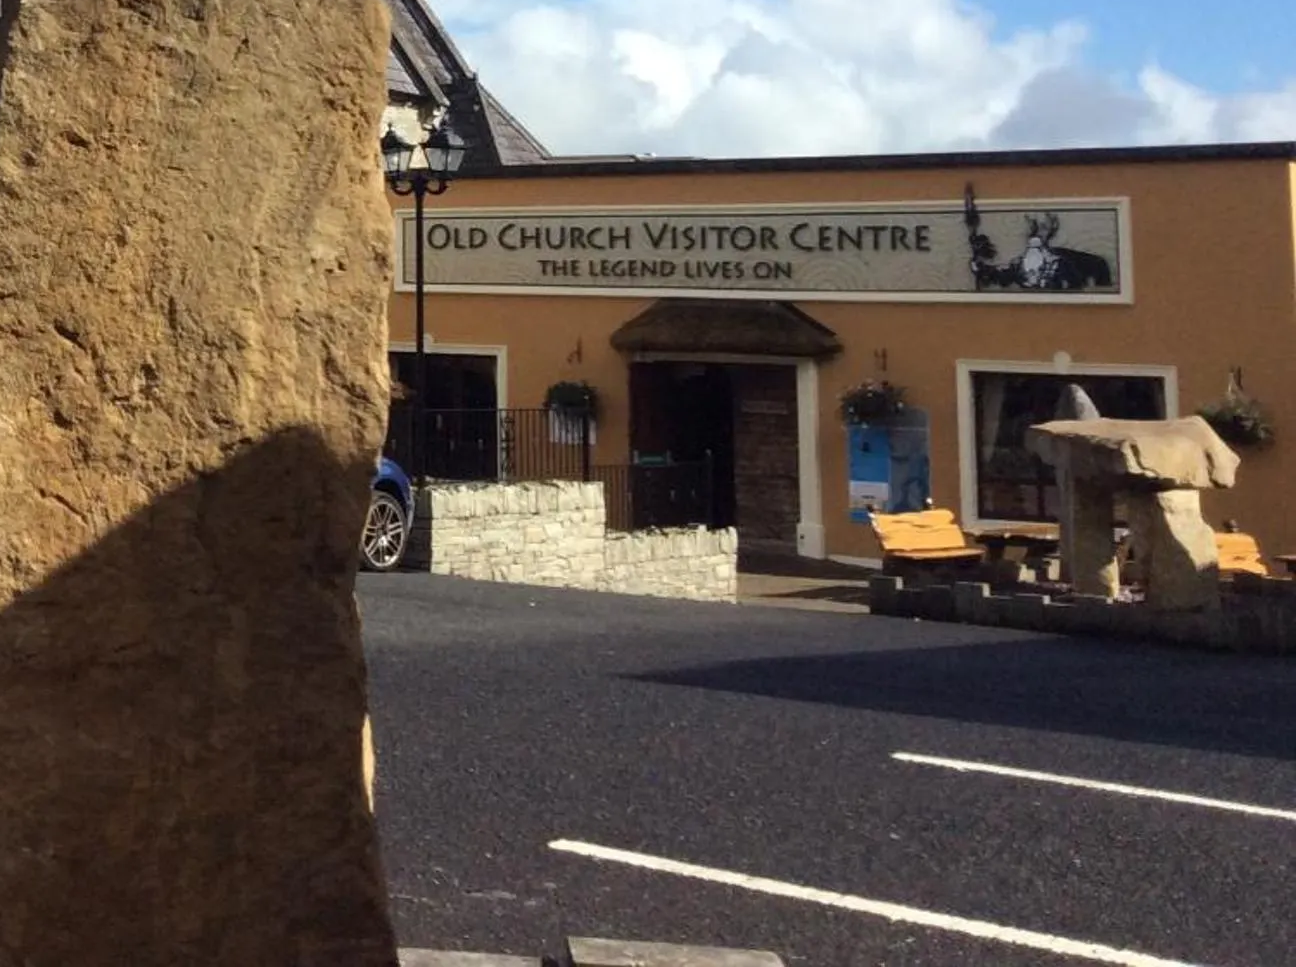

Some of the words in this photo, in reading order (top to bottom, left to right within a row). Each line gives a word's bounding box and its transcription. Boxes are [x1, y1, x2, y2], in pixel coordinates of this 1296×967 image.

[426, 223, 488, 250] OLD
[498, 223, 630, 251] CHURCH
[642, 222, 779, 251] VISITOR
[789, 222, 931, 251] CENTRE
[537, 259, 580, 277] THE
[588, 259, 676, 278] LEGEND
[684, 260, 745, 279] LIVES
[753, 261, 793, 280] ON
